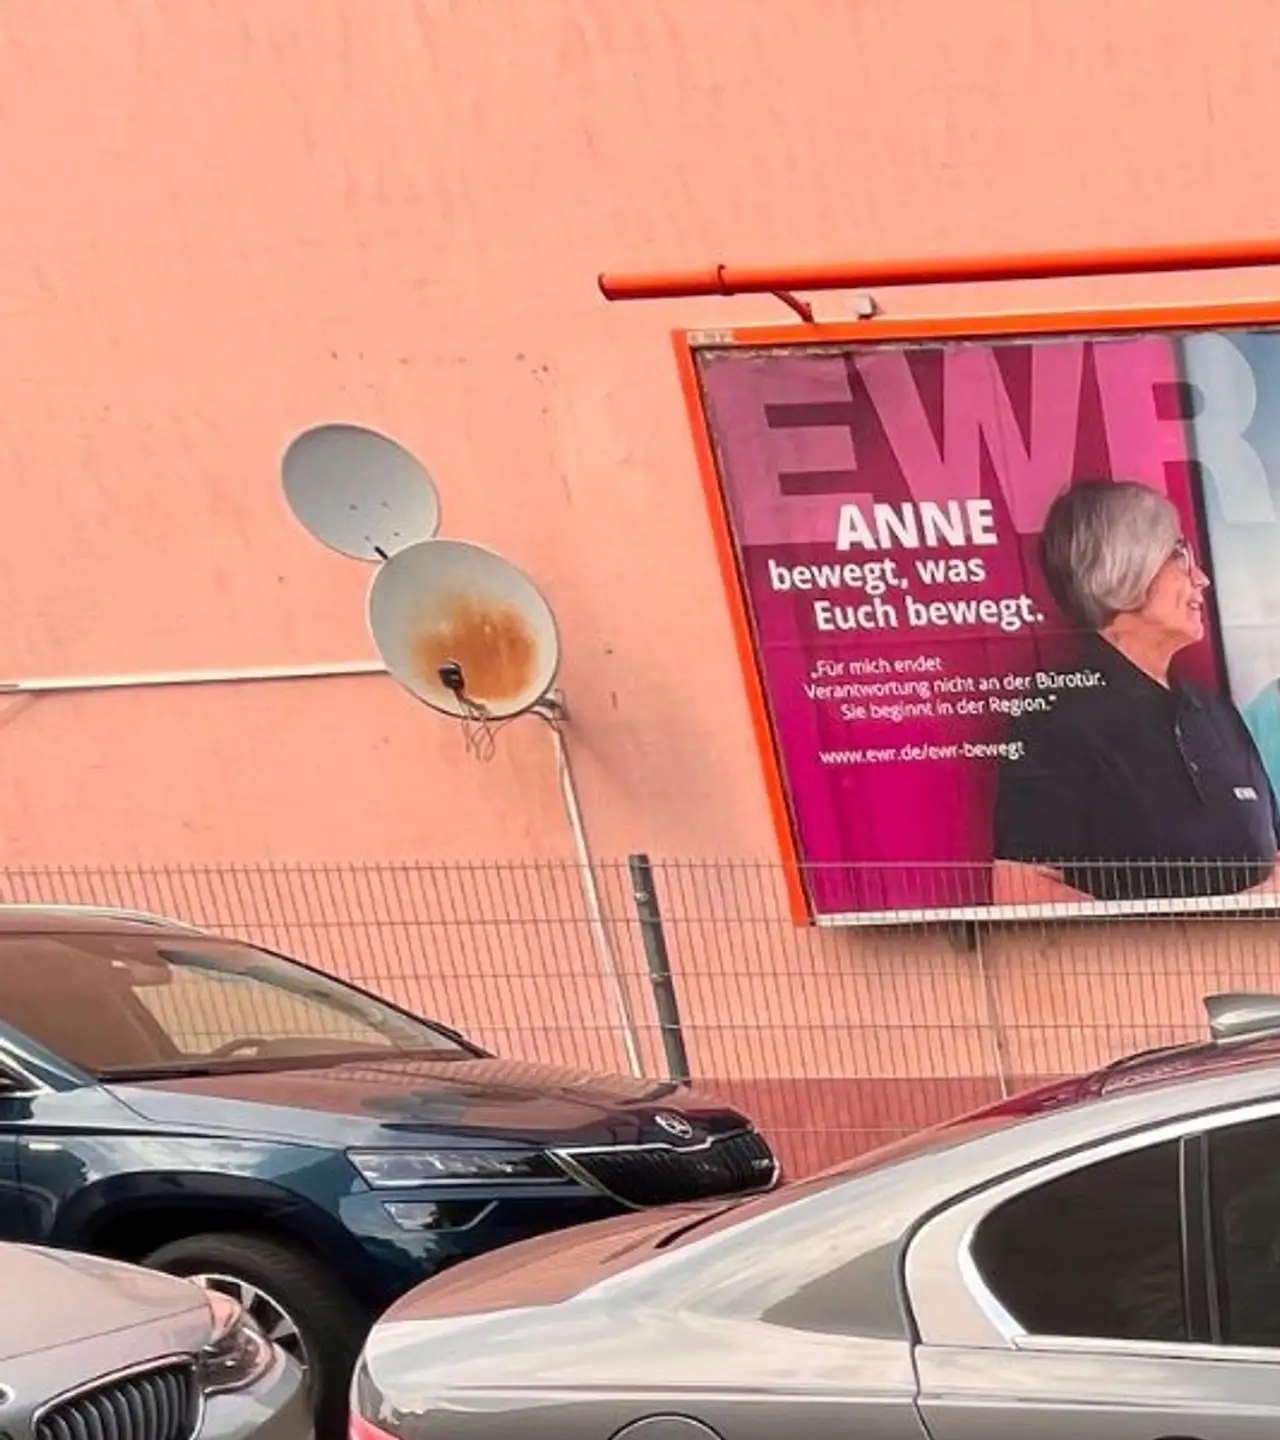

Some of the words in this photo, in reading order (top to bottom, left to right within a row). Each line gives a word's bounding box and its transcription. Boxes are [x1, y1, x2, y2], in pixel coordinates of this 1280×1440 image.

[702, 334, 1277, 545] EWR
[836, 499, 998, 551] ANNE
[768, 557, 909, 595] bewegt,
[915, 556, 986, 585] was
[813, 597, 898, 631] Euch
[905, 594, 1044, 631] bewegt.
[850, 658, 891, 676] mich
[894, 655, 943, 674] endet
[804, 679, 931, 699] Verantwortung
[933, 677, 975, 695] nicht
[979, 675, 1001, 692] an
[1003, 672, 1032, 691] der
[1035, 668, 1107, 690] Bürotür.
[841, 702, 866, 721] Sie
[870, 700, 934, 723] beginnt
[937, 699, 955, 717] in
[957, 697, 986, 715] der
[818, 739, 1026, 765] www.ewr.de/ewr-bewegt
